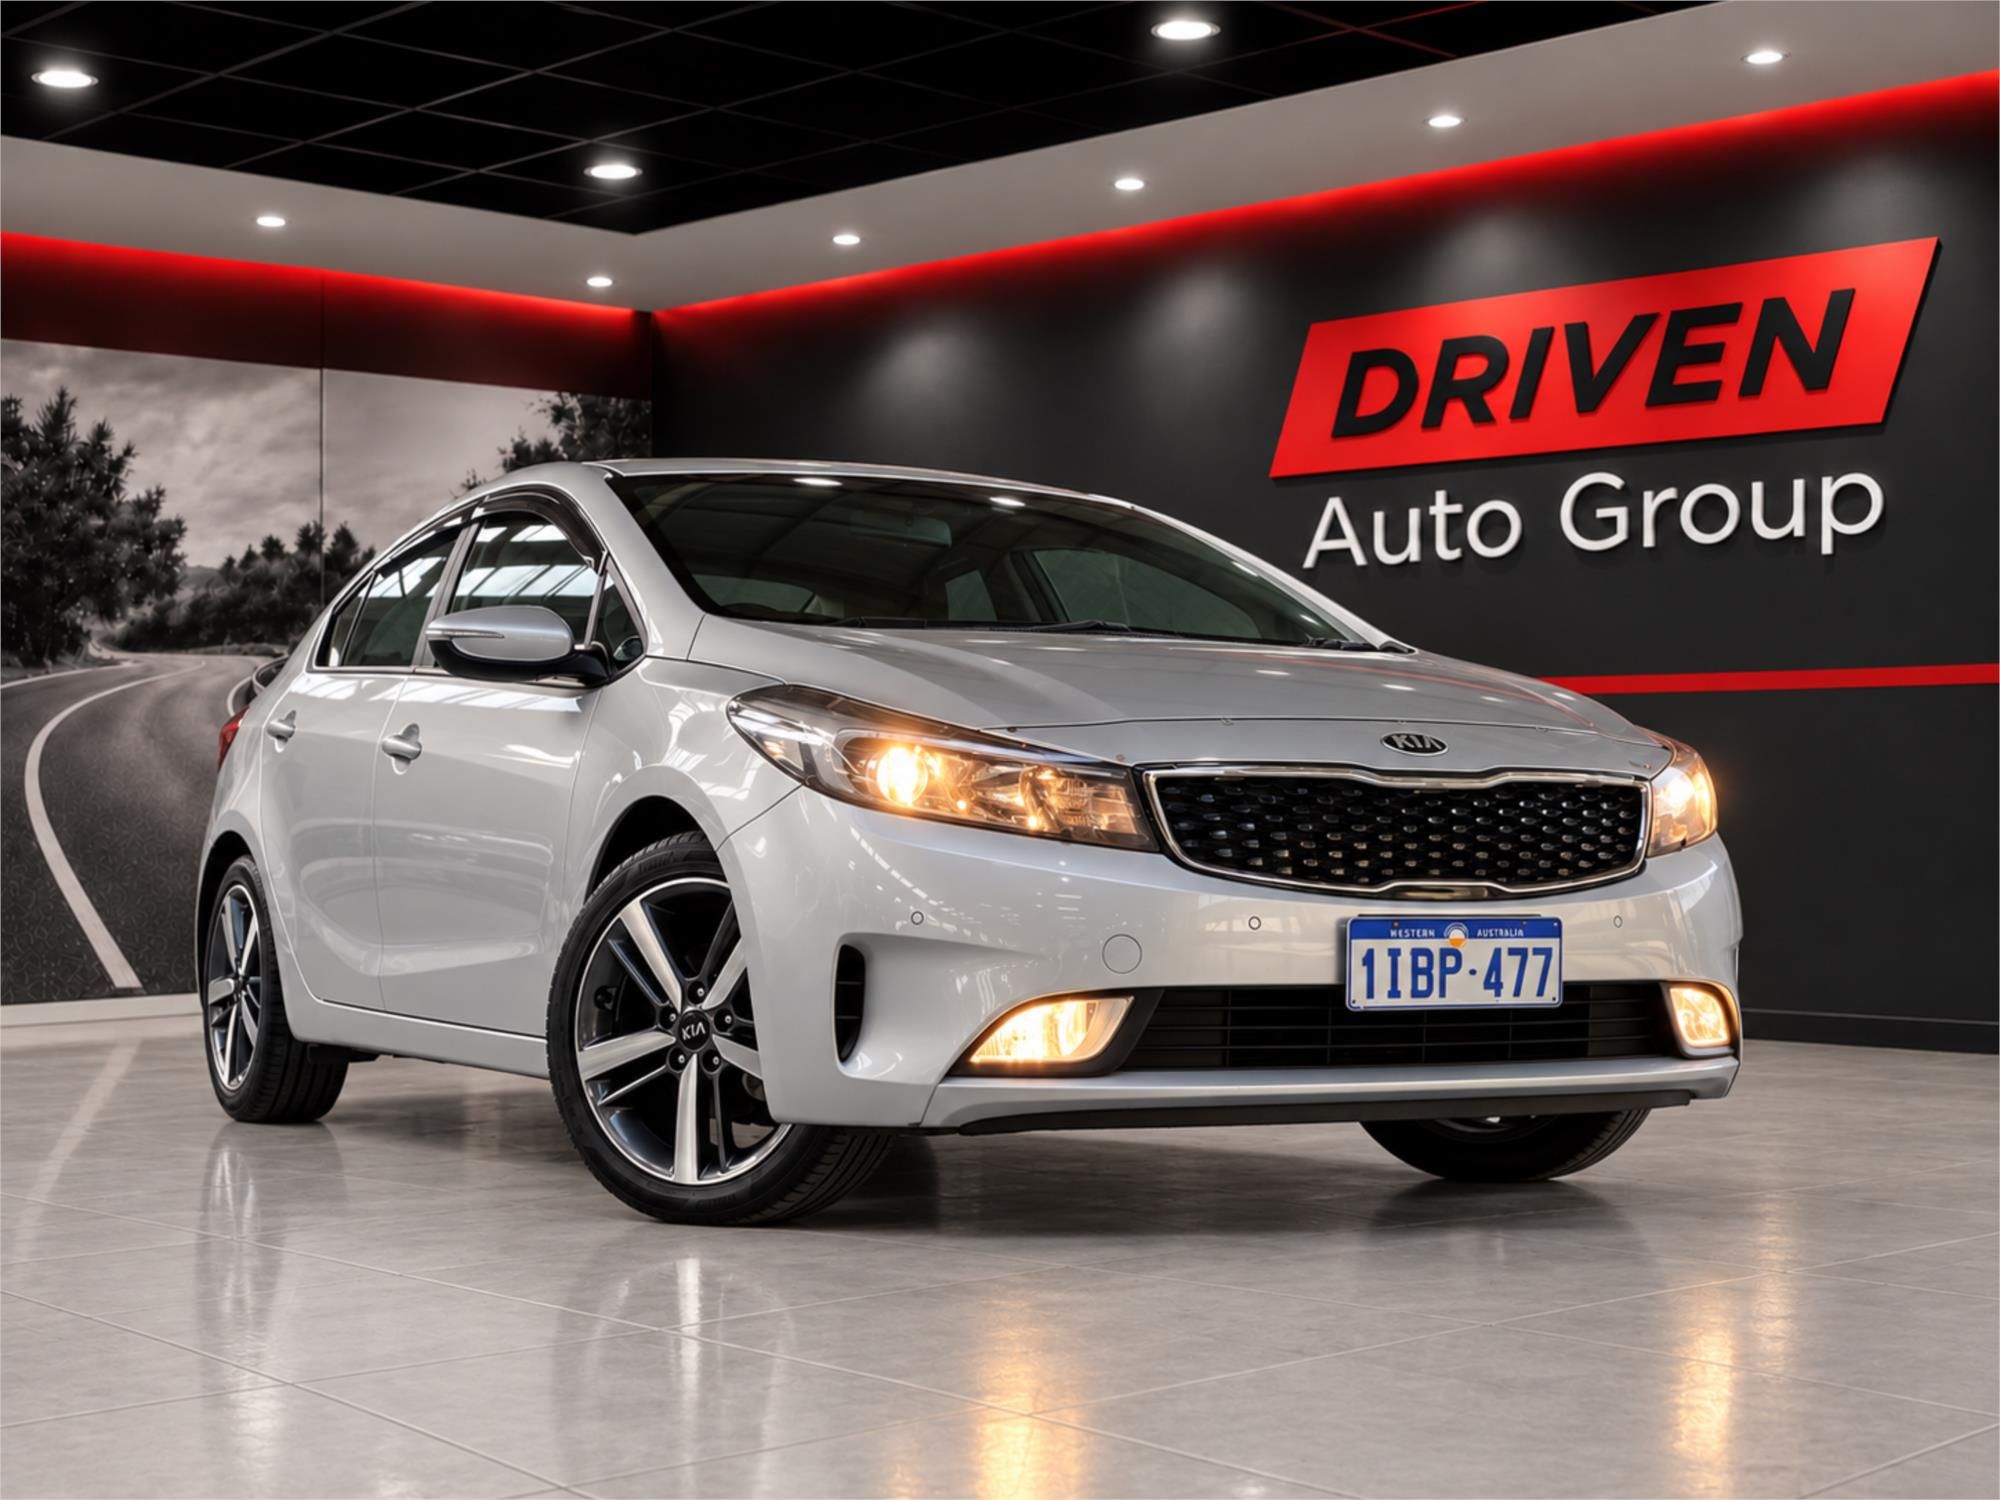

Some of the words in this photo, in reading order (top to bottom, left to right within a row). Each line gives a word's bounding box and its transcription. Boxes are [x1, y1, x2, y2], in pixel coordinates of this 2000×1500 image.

[1331, 288, 1855, 439] DRIVEN
[1302, 490, 1523, 568] Auto
[1560, 472, 1884, 555] Group
[1391, 735, 1442, 749] KIA
[1390, 928, 1435, 937] WESTERN
[1477, 928, 1524, 937] AUSTRALIA
[682, 1021, 706, 1040] KIA
